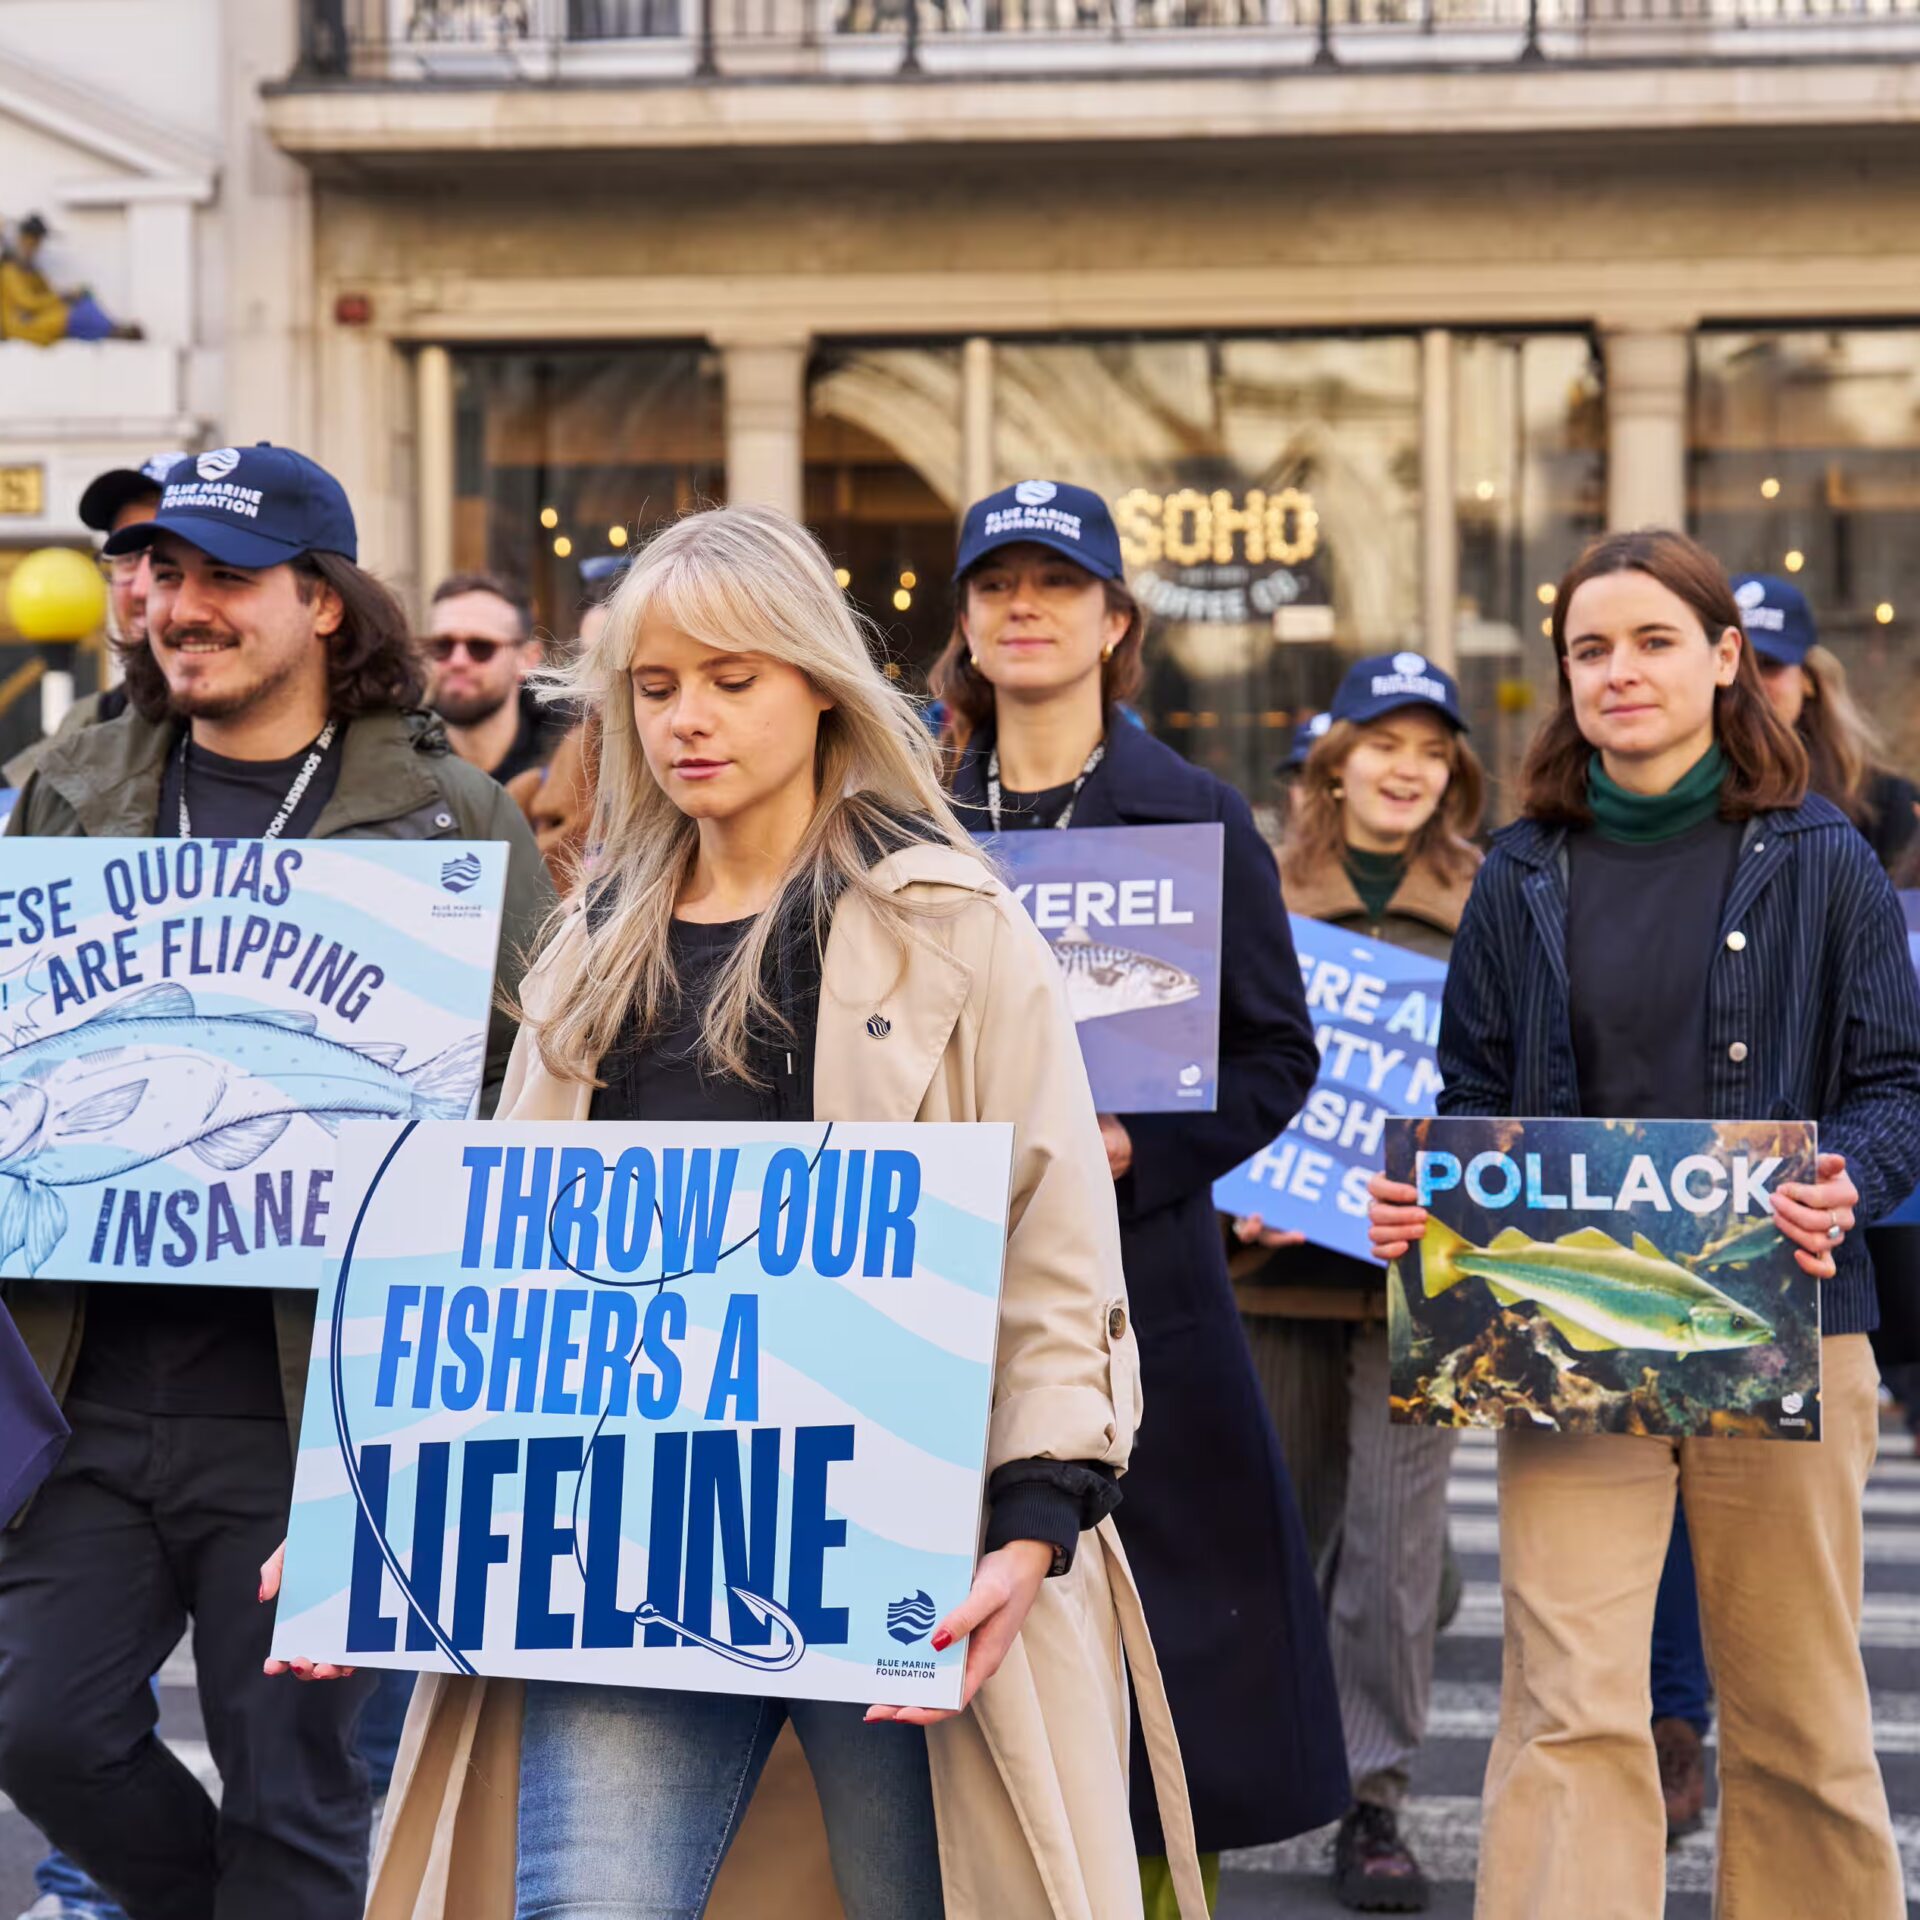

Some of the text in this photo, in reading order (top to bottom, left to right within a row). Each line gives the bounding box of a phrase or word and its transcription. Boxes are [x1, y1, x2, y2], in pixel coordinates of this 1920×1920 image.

[162, 493, 259, 518] FOUNDATION
[164, 482, 263, 504] BLUE MARINE
[1024, 507, 1081, 529] MARINE
[984, 517, 1081, 541] FOUNDATION
[1116, 487, 1318, 566] SOHO
[282, 752, 322, 814] SOMERSET
[103, 839, 303, 919] QUOTAS
[48, 914, 385, 1024] ARE FLIPPING
[461, 1145, 922, 1278] THROW OUR
[1415, 1150, 1784, 1214] POLLACK
[88, 1169, 334, 1268] INSANE
[374, 1285, 760, 1422] FISHERS A
[345, 1424, 856, 1654] LIFELINE
[875, 1668, 936, 1679] FOUNDATION
[877, 1658, 936, 1670] BLUE MARINE
